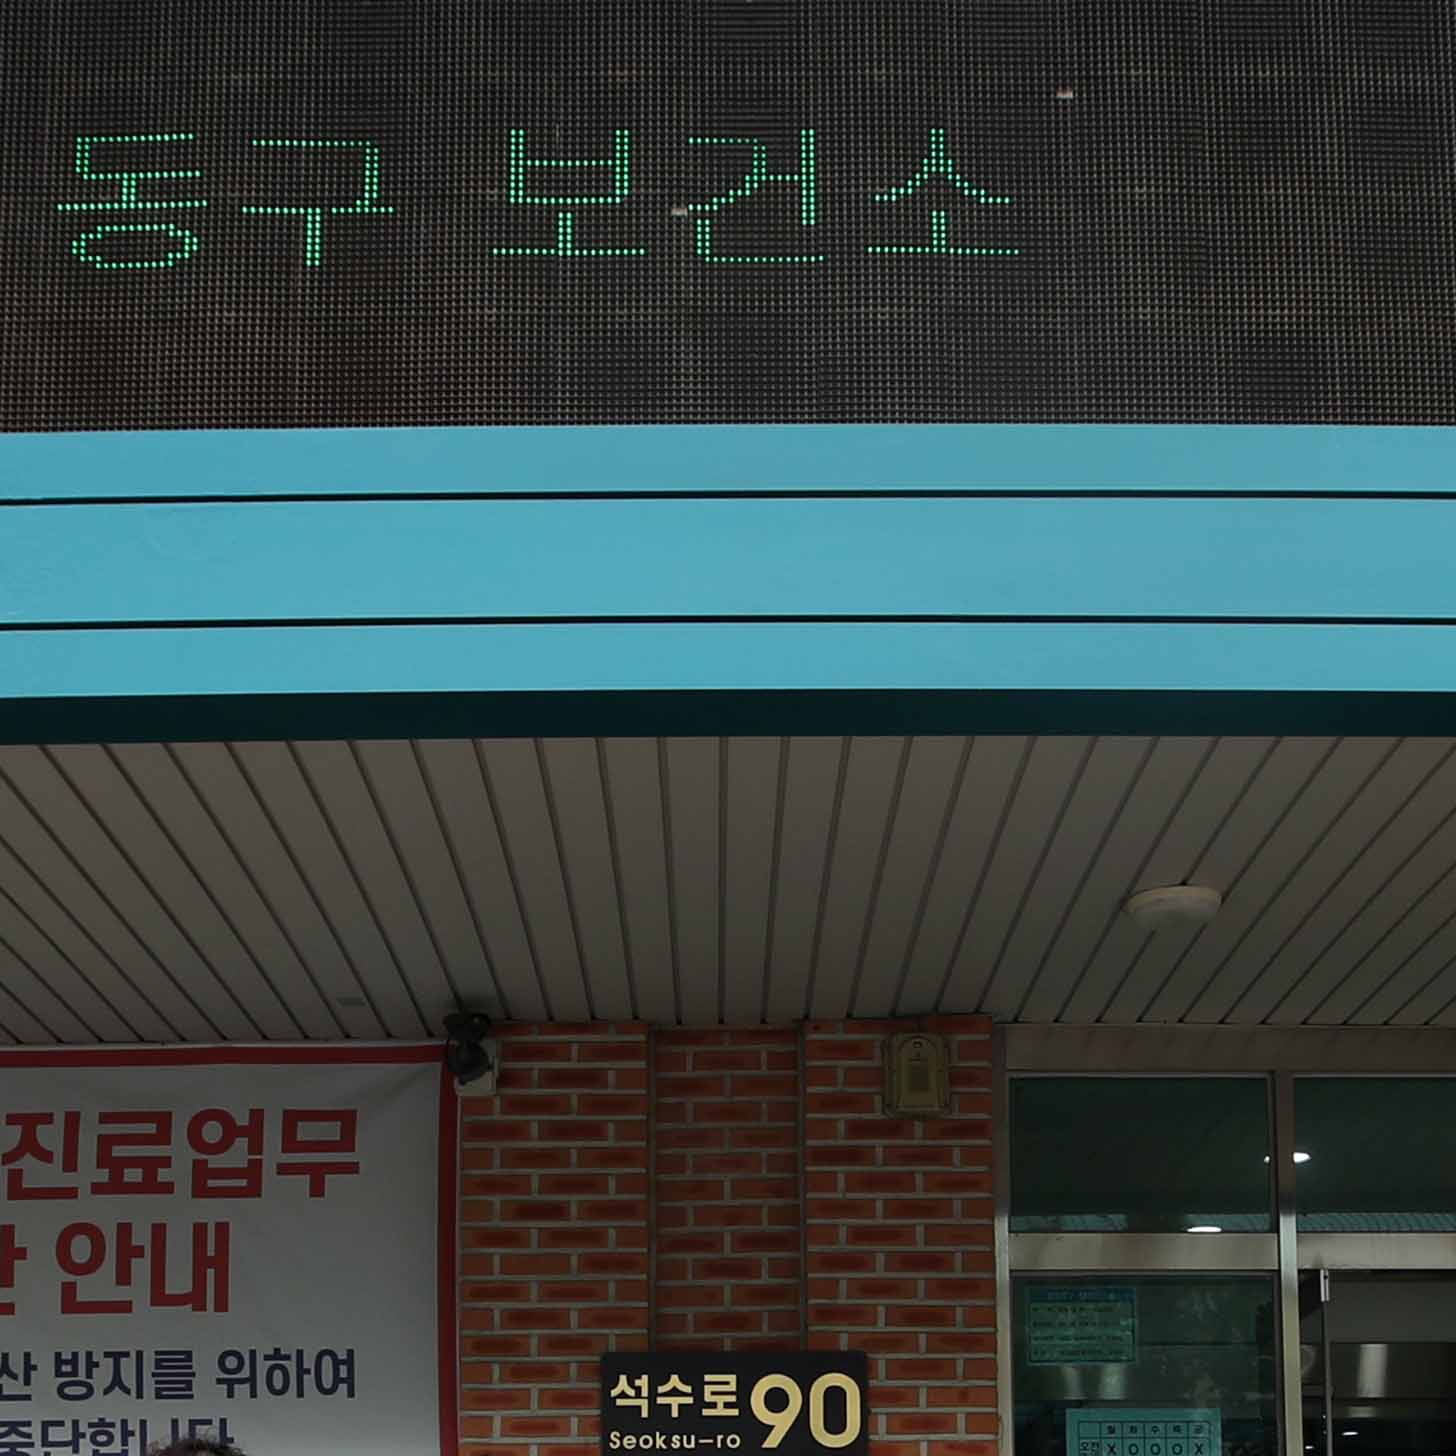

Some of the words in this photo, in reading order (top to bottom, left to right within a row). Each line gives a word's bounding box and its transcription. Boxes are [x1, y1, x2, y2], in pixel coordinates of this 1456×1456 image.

[56, 132, 396, 271] 동구
[490, 125, 1022, 263] 보건소
[54, 1219, 232, 1315] 안내
[53, 1348, 197, 1401] 방지를
[214, 1347, 358, 1400] 위하여
[609, 1374, 740, 1420] 석수로
[750, 1372, 863, 1450] 90
[609, 1430, 742, 1452] Seoksu-ro
